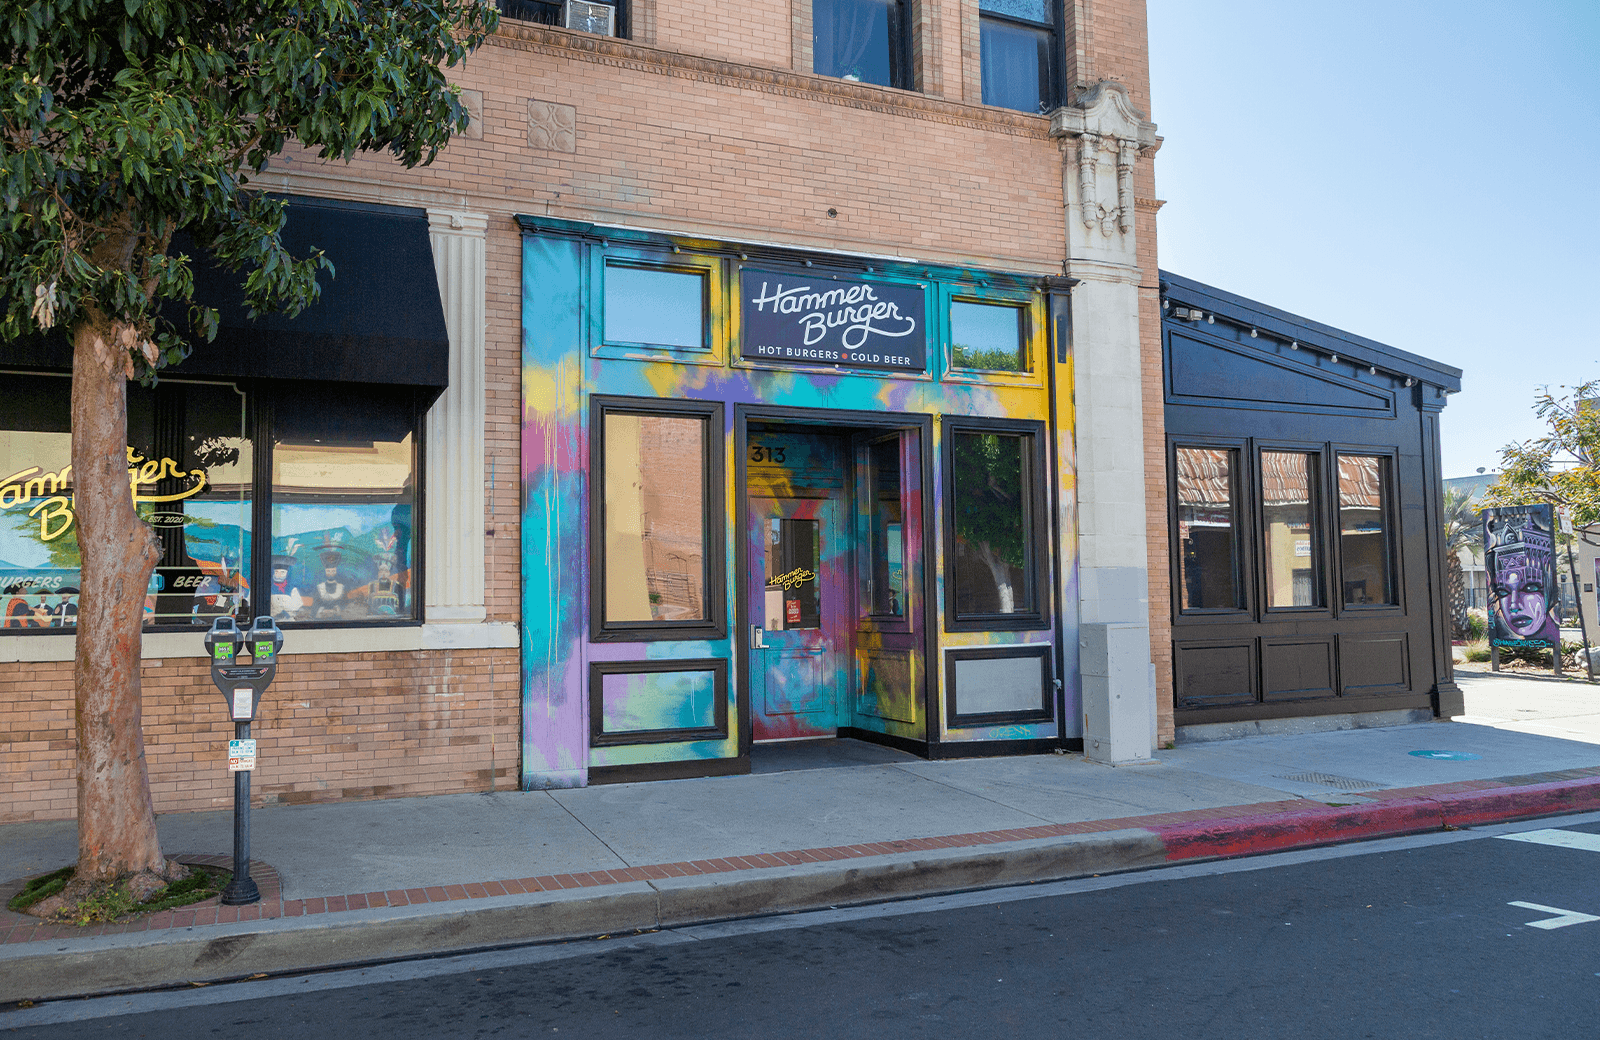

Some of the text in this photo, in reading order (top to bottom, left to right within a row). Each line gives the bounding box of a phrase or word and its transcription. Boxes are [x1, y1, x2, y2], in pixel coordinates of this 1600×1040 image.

[752, 281, 878, 314] Hammer
[799, 302, 915, 349] Burger
[758, 345, 911, 366] HOT BURGERS COLD BEER
[752, 446, 786, 463] 313
[164, 515, 184, 524] 2020
[0, 576, 63, 589] URGERS
[173, 576, 212, 589] BEER
[769, 567, 803, 585] Hammer
[782, 570, 816, 591] Burger
